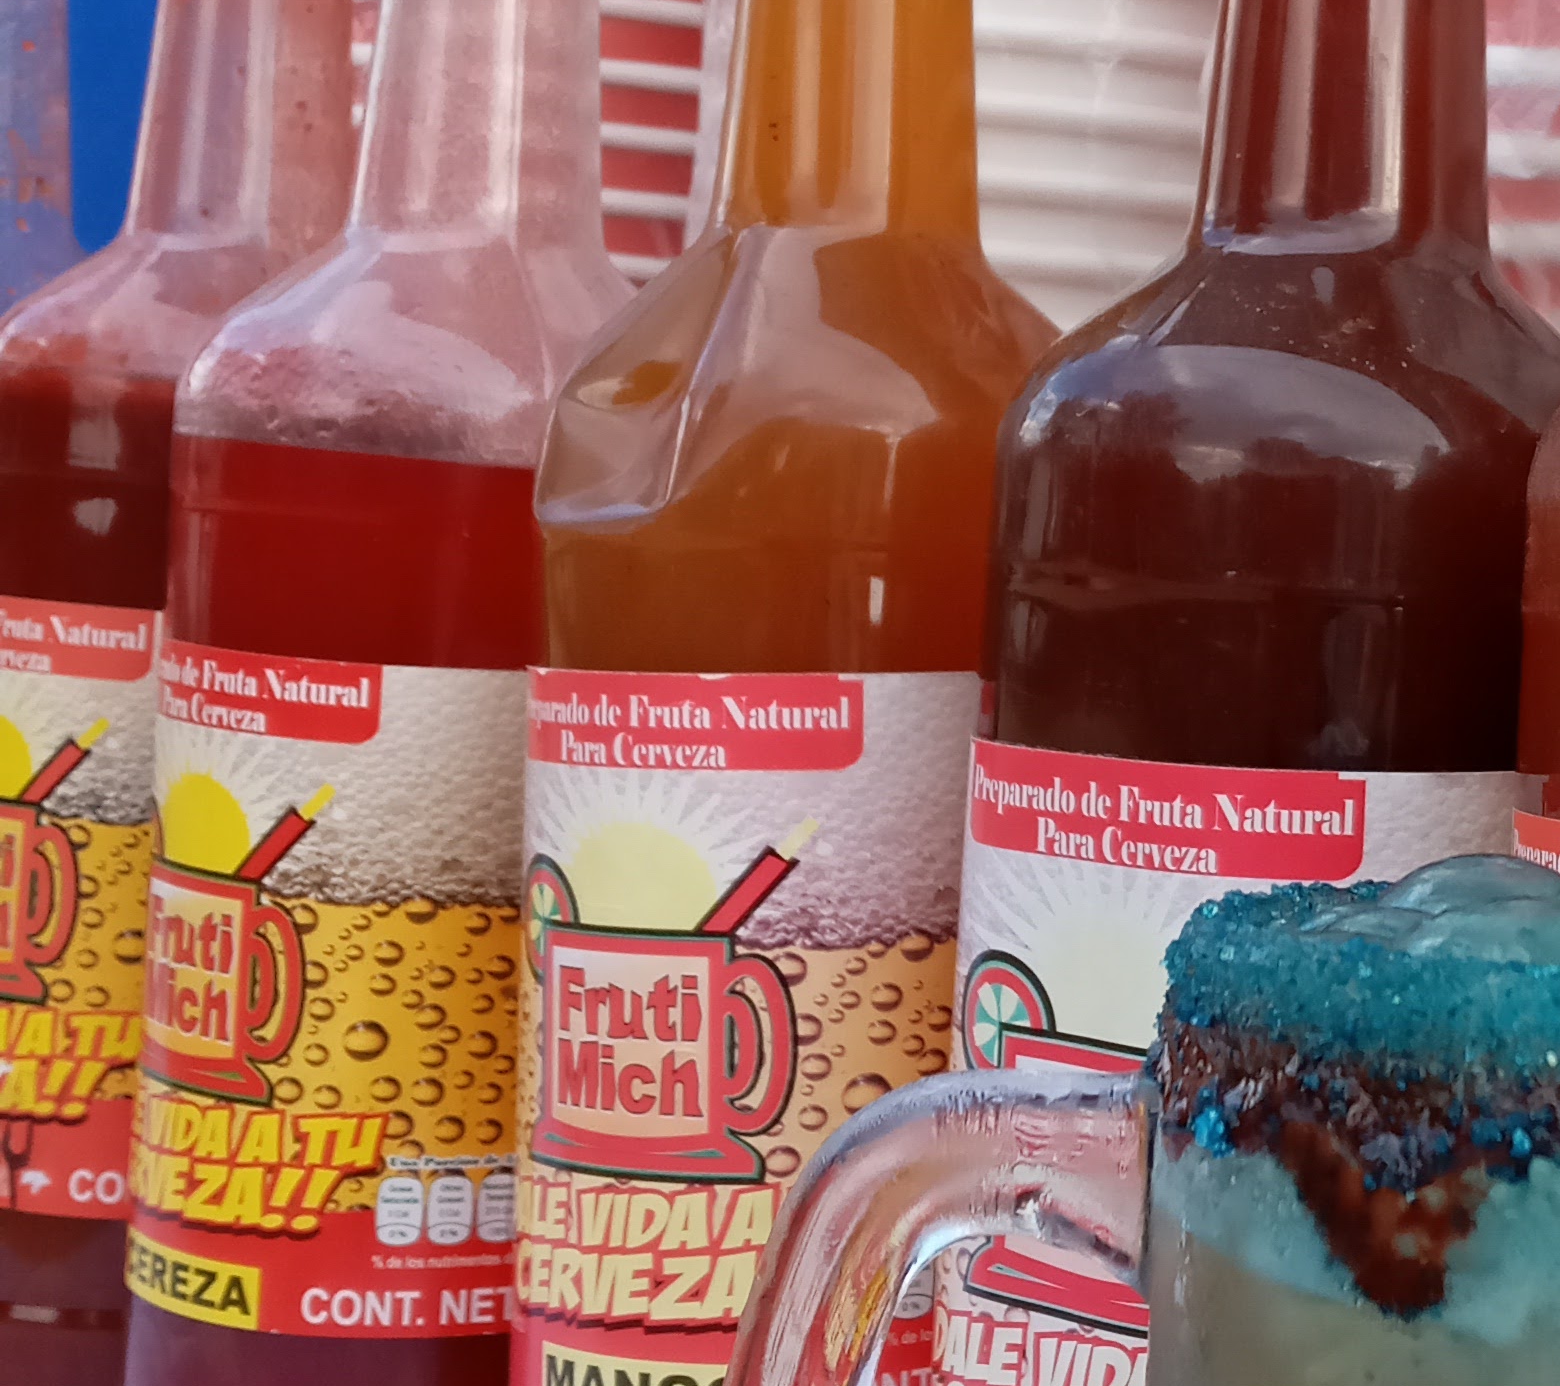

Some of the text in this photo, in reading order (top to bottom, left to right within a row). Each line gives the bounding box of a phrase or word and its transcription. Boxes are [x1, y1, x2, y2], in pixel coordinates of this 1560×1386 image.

[50, 614, 148, 652] Natural
[203, 659, 258, 697] Fruta
[262, 667, 371, 709] Natural
[191, 691, 267, 734] Cerveza
[594, 693, 622, 728] de
[628, 693, 712, 731] Fruta
[720, 694, 850, 731] Natural
[560, 728, 727, 769] Para Cerveza
[973, 762, 1356, 837] Preparado de Fruta Natural
[1036, 816, 1218, 875] Para Cerveza
[558, 964, 702, 1043] Fruti
[557, 1036, 704, 1118] Mich
[298, 1115, 384, 1168] TU
[580, 1191, 710, 1251] VIDA
[518, 1238, 757, 1321] CERVEZA
[300, 1287, 425, 1326] CONT.
